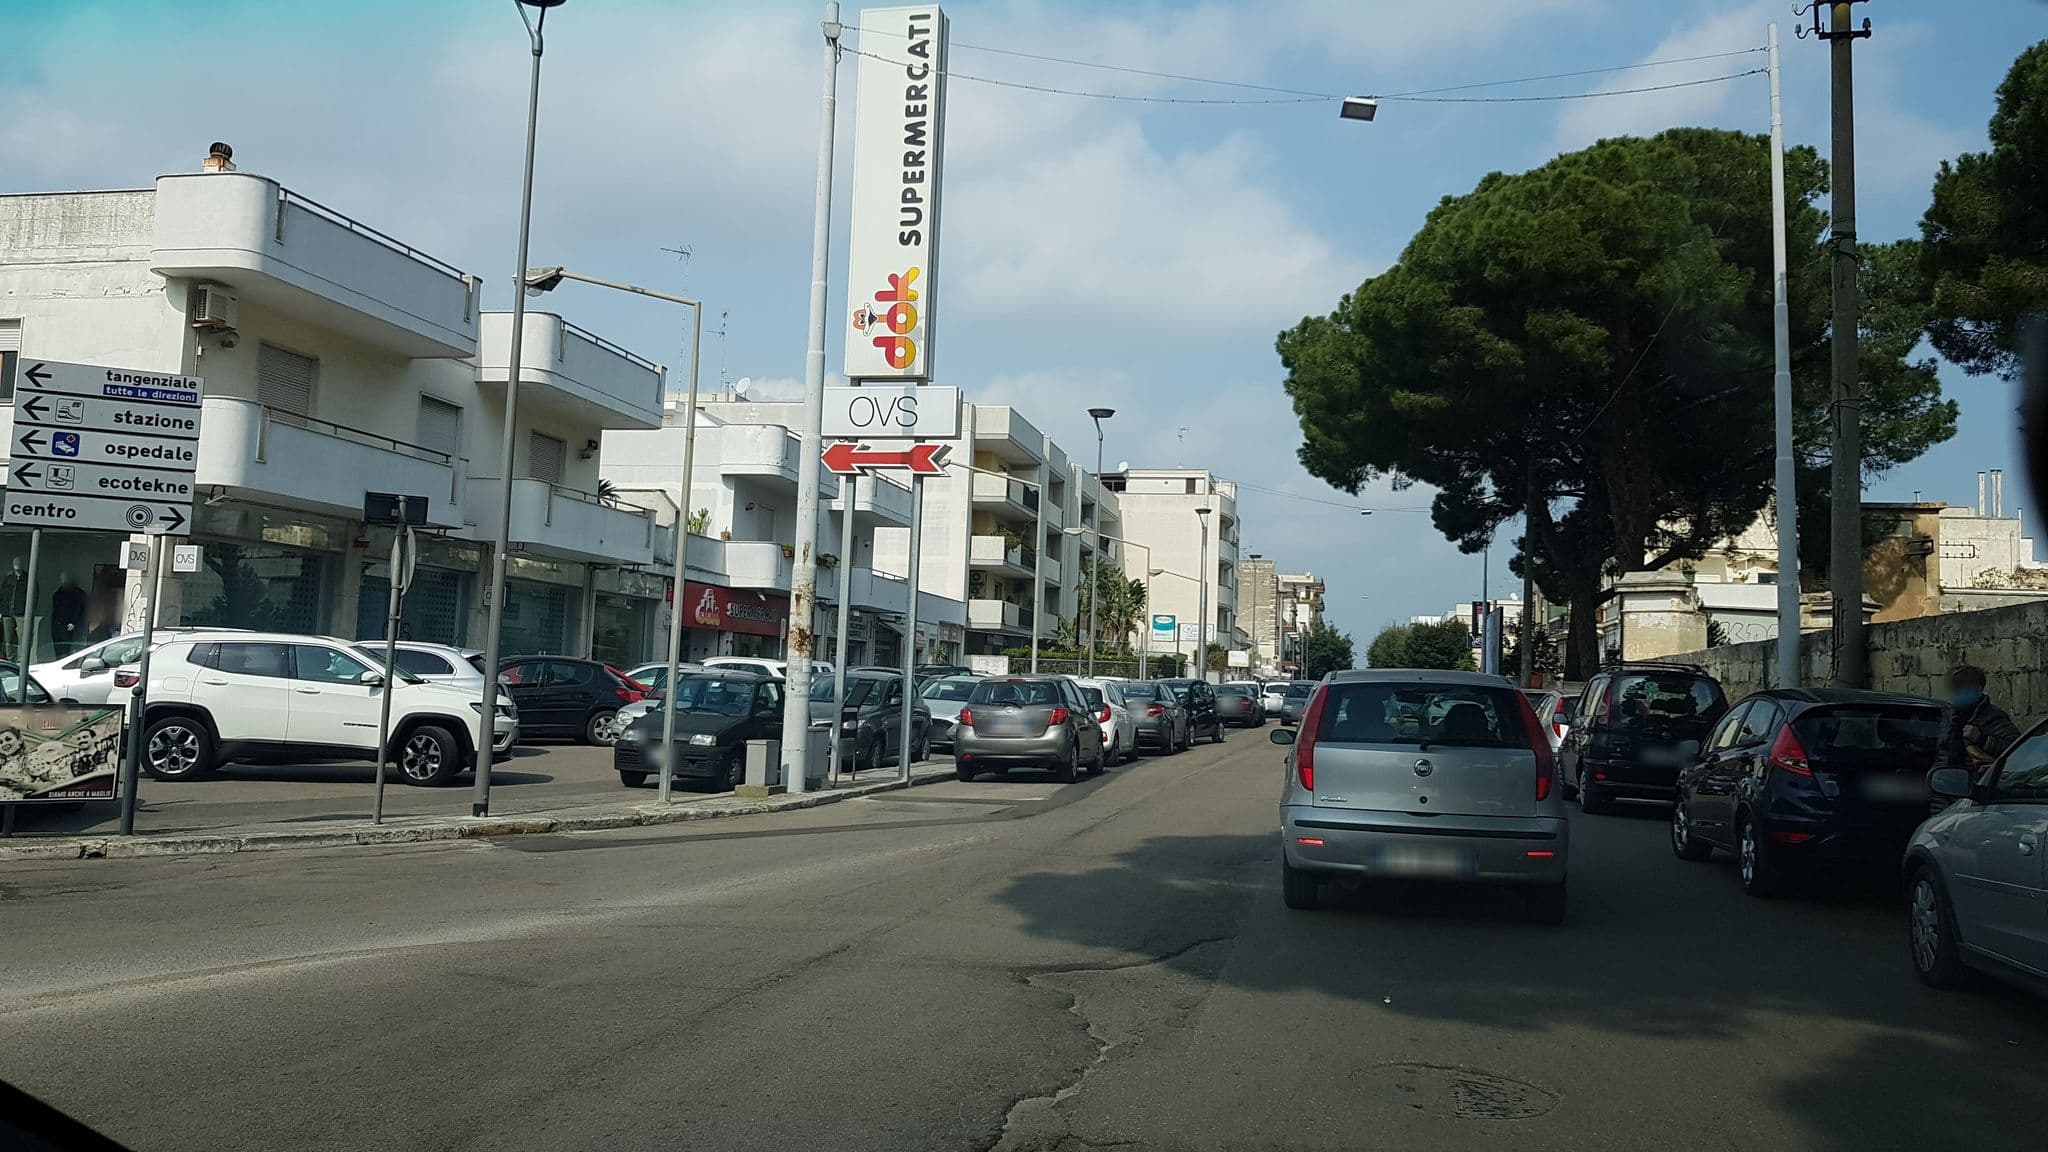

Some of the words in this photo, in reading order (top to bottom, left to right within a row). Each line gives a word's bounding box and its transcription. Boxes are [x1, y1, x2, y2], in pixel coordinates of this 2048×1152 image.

[899, 12, 931, 247] SUPERMERCATI
[871, 266, 920, 369] dok
[106, 369, 197, 389] tangenziale
[106, 385, 133, 396] tutte
[137, 389, 147, 397] le
[152, 390, 195, 402] direzioni
[113, 410, 195, 430] stazione
[848, 395, 918, 428] OVS
[104, 441, 193, 461] ospedale
[98, 476, 188, 495] ecotekne
[10, 503, 77, 519] centro
[129, 550, 147, 562] OVS
[175, 553, 195, 564] OVS
